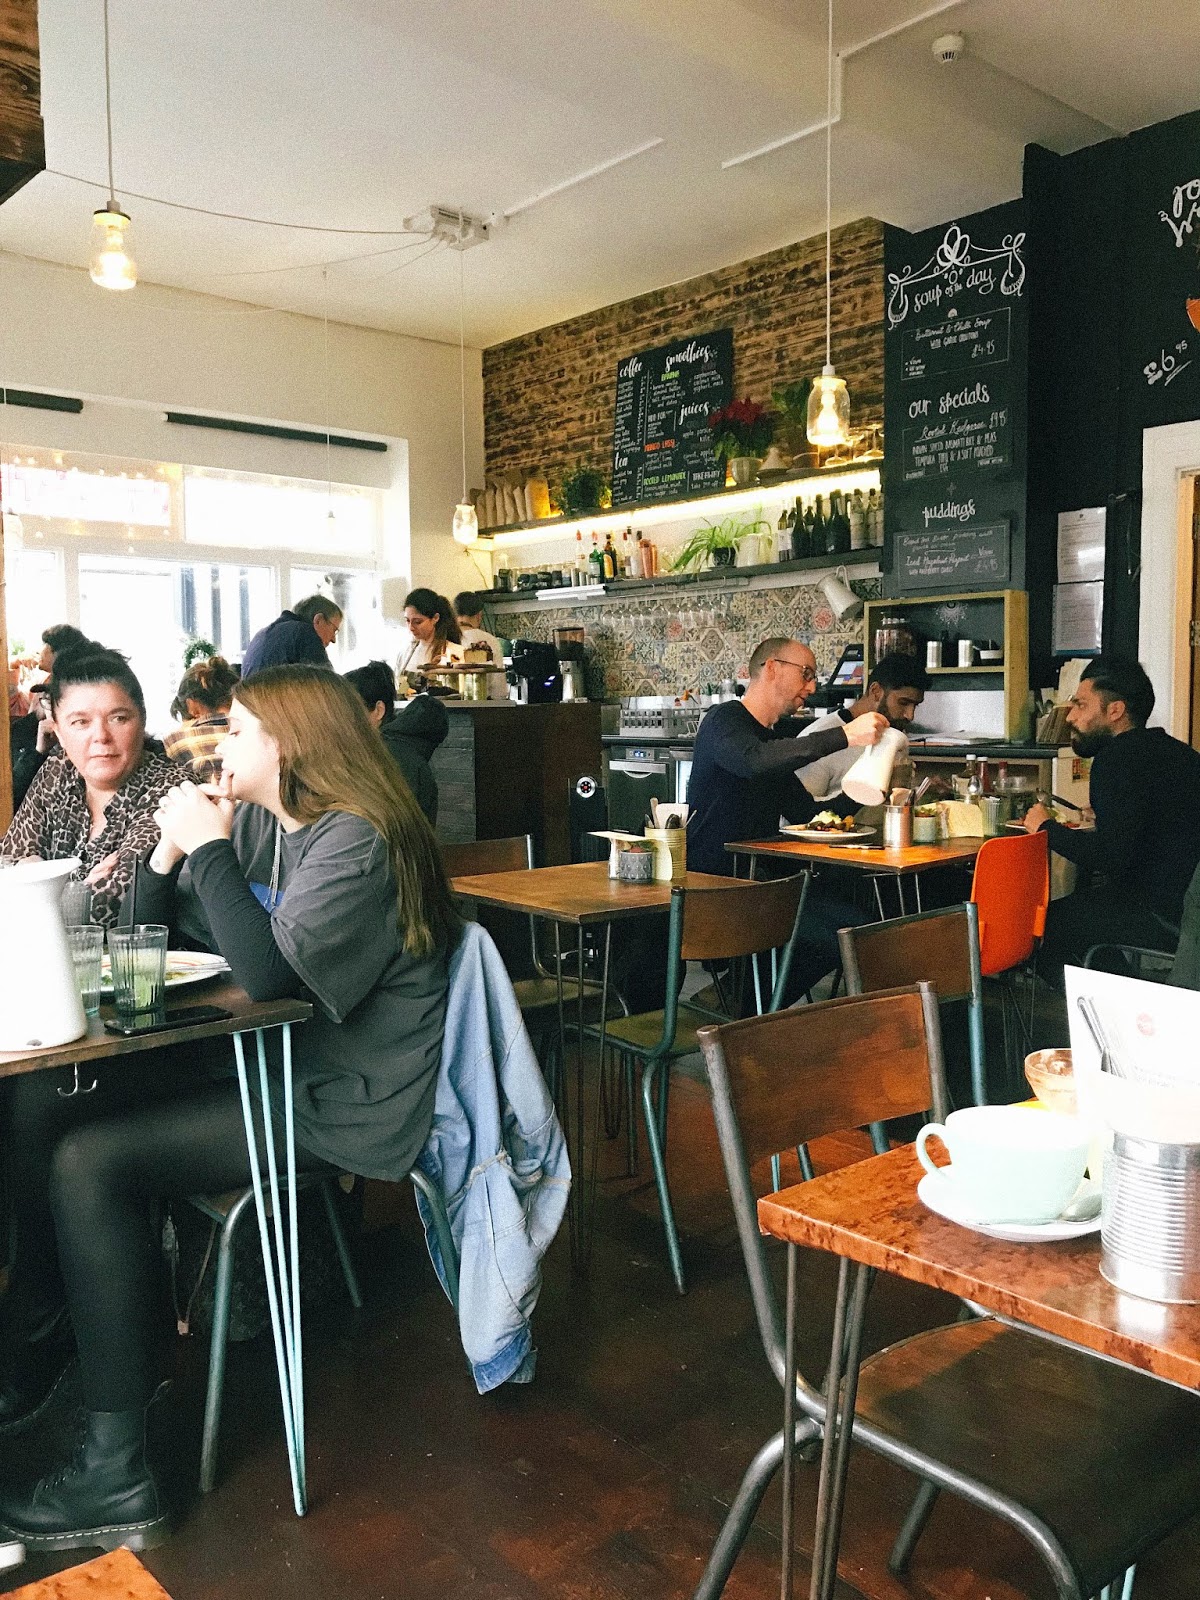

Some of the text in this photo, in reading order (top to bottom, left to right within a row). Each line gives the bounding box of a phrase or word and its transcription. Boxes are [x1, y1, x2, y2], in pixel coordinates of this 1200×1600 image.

[914, 284, 942, 313] soup
[966, 268, 997, 295] day
[619, 357, 643, 378] coffee
[665, 341, 711, 373] smoothies
[678, 401, 710, 426] juices
[908, 382, 990, 419] our specials
[614, 452, 629, 471] tea
[921, 499, 976, 527] puddings
